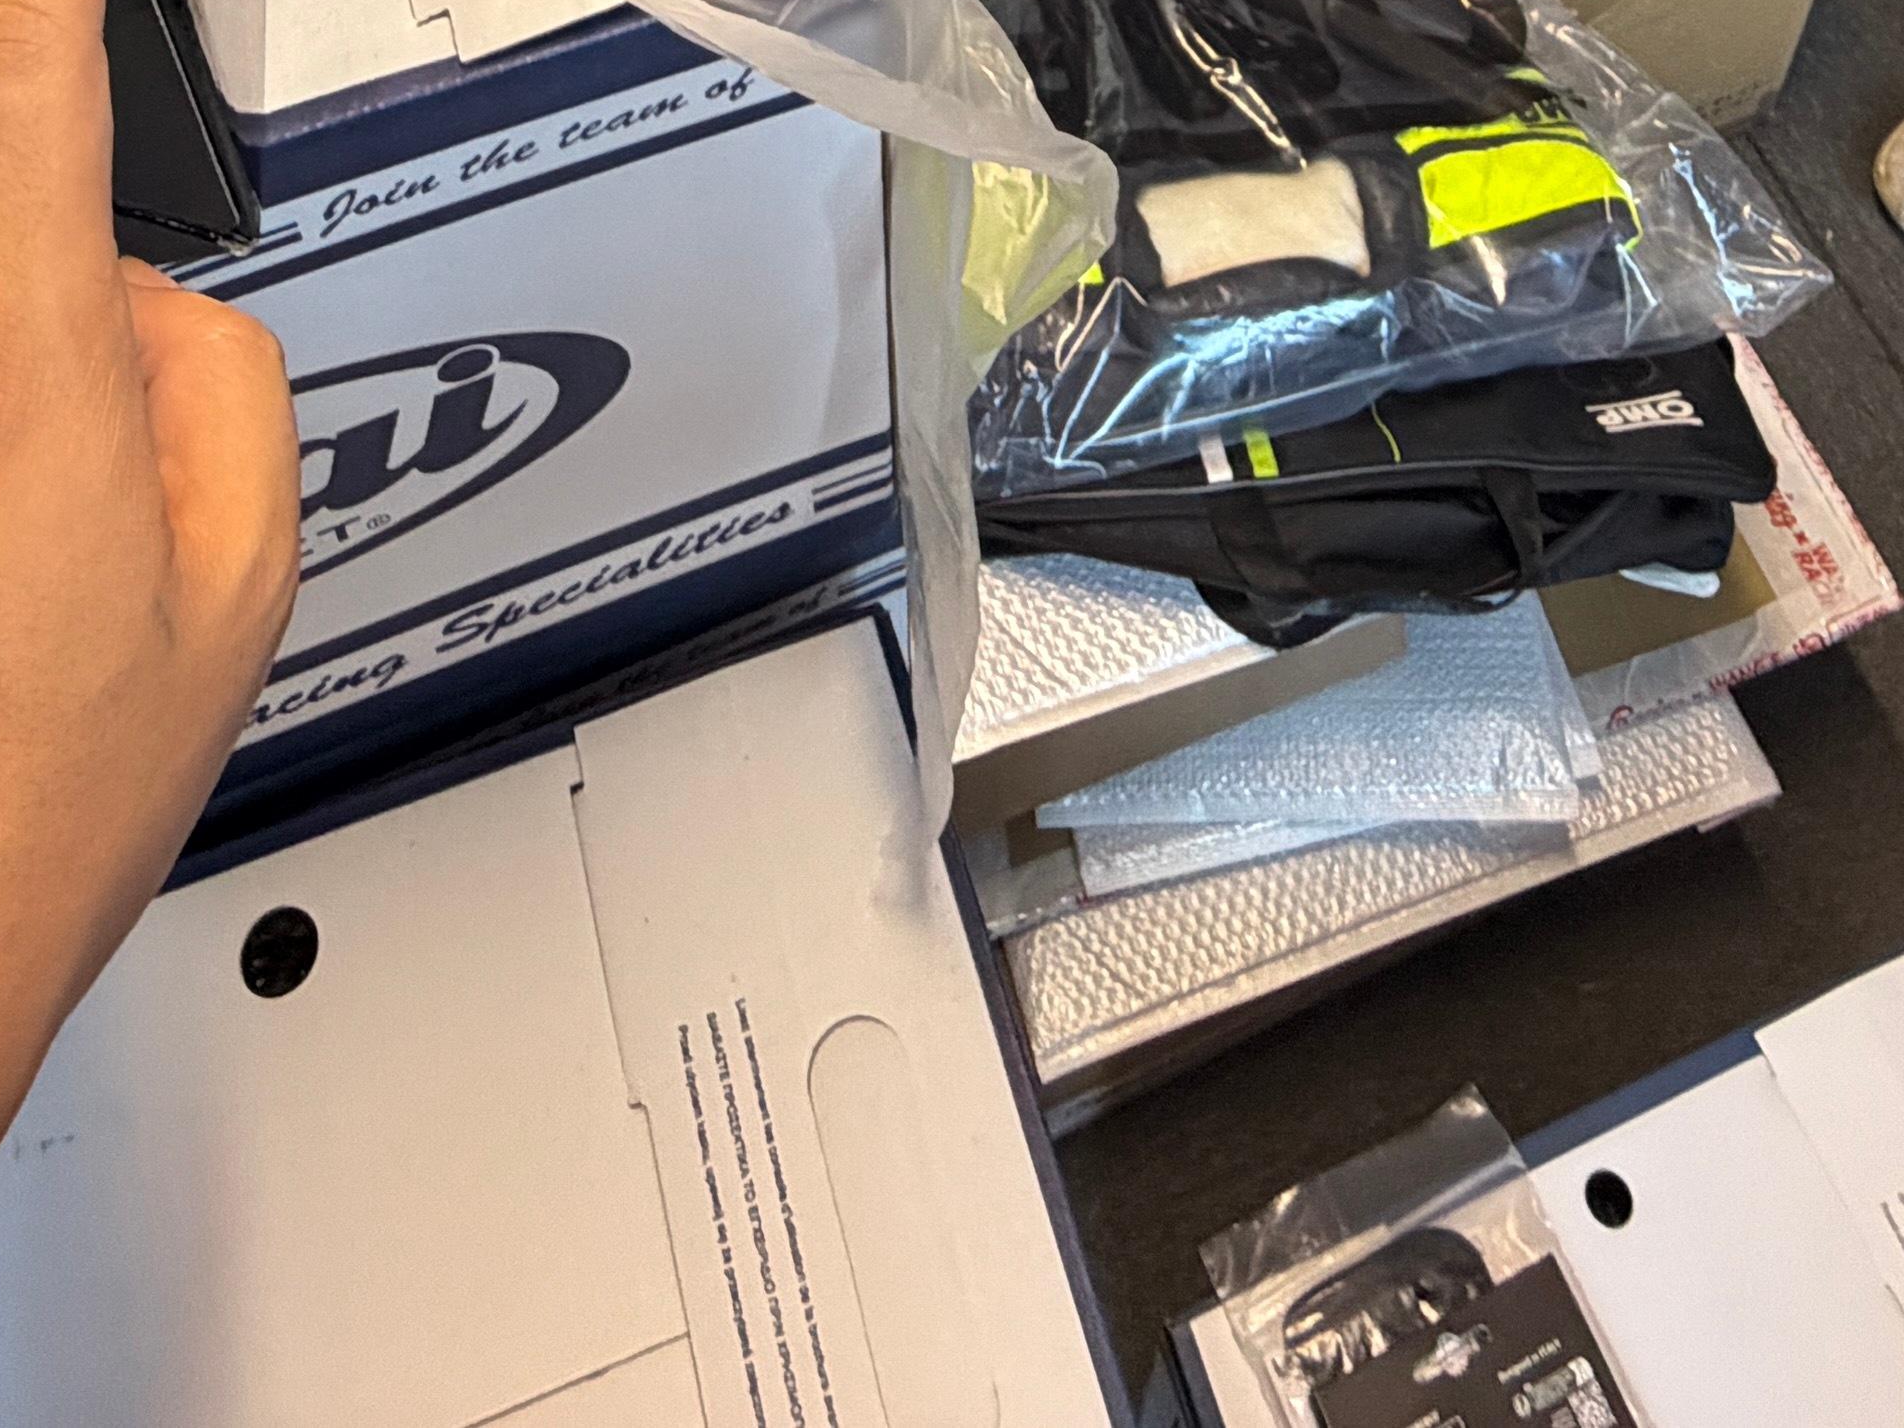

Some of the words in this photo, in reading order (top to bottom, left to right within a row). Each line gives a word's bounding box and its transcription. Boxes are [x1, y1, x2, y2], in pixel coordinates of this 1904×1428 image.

[318, 172, 441, 238] Join
[459, 140, 540, 186] the
[556, 92, 688, 151] team
[703, 66, 757, 122] of
[1597, 399, 1696, 431] OMP
[246, 651, 408, 730] acing
[434, 501, 794, 656] Specialities
